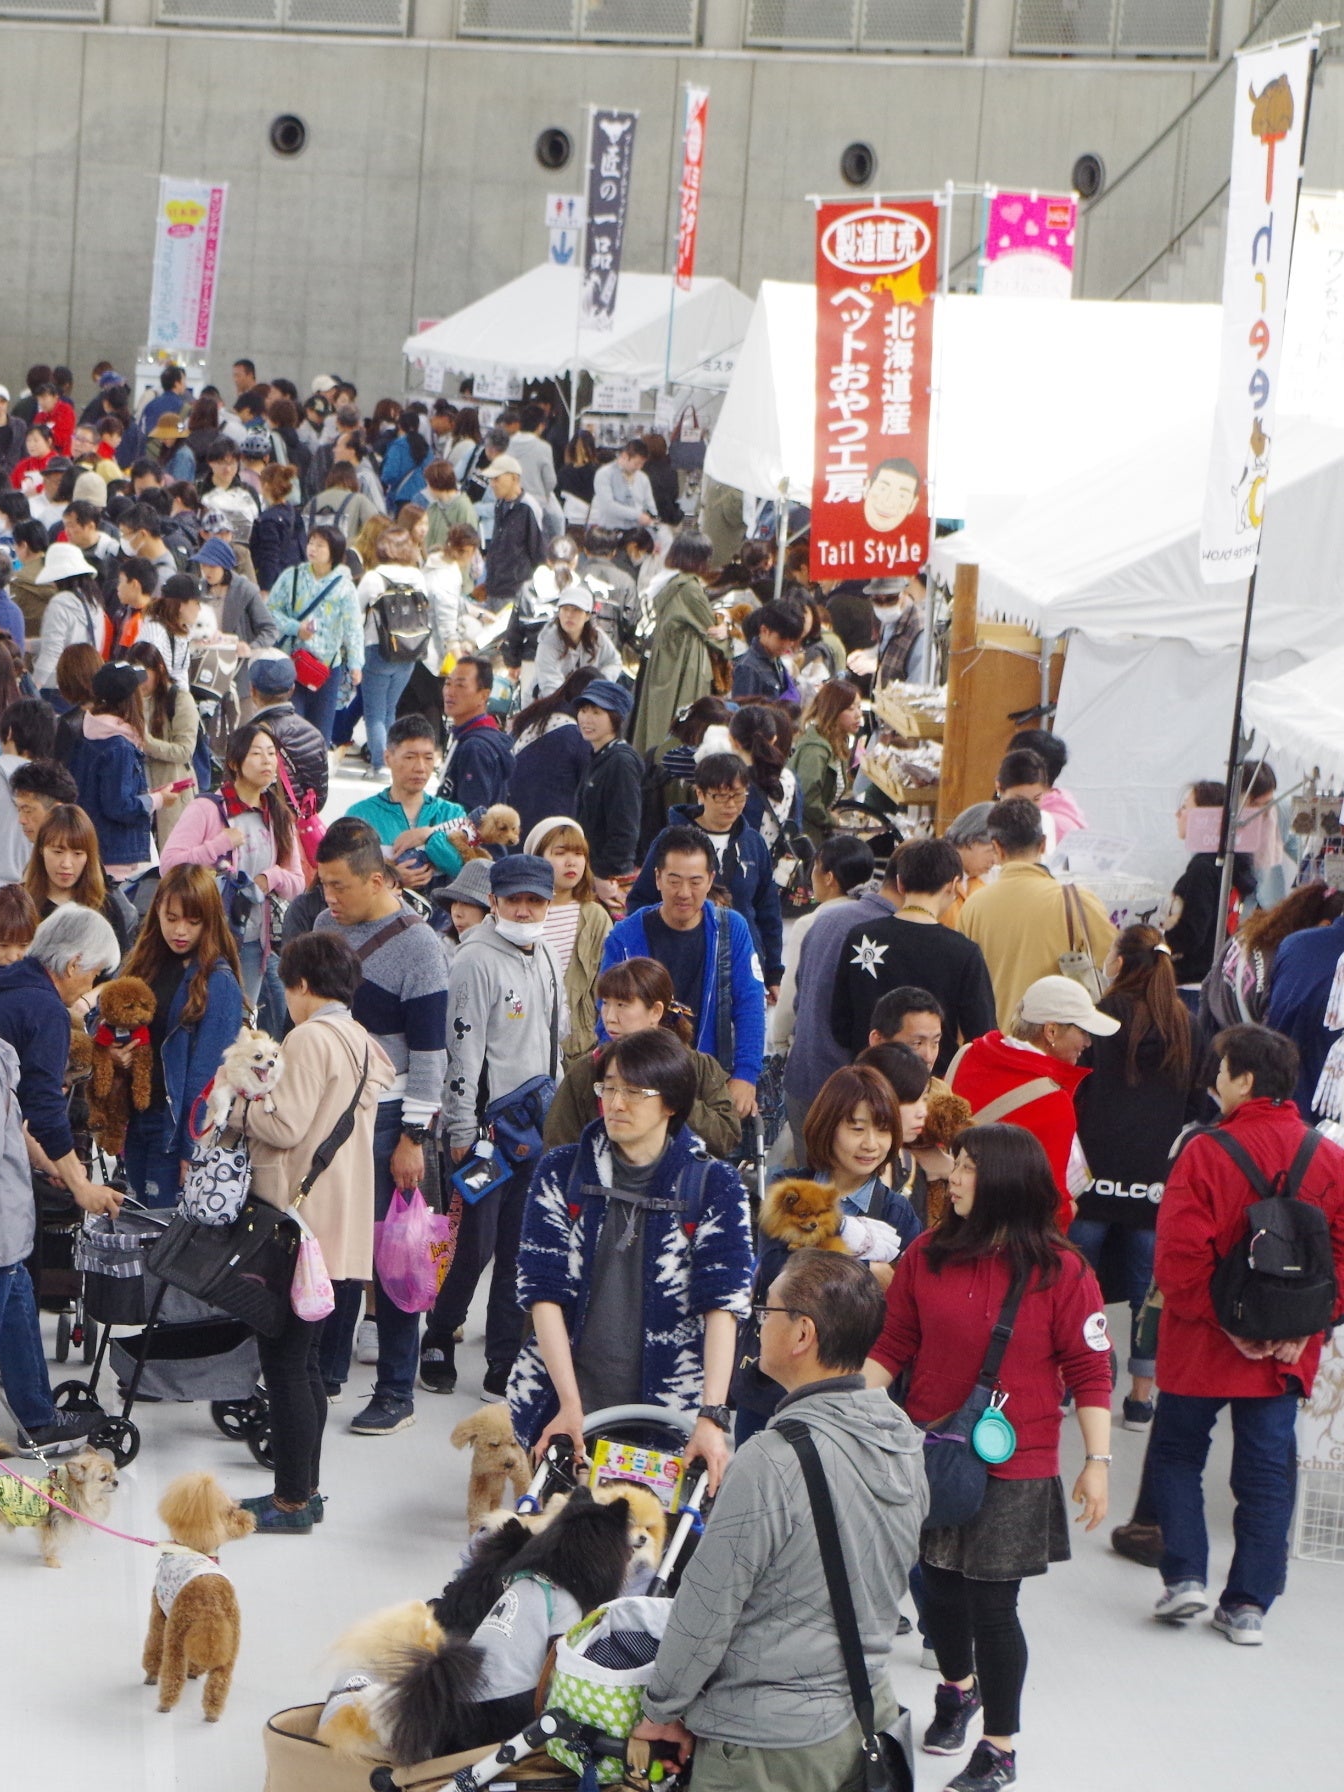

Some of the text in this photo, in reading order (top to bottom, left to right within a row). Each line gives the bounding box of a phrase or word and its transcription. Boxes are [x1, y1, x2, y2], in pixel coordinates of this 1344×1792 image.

[591, 146, 623, 270] 匠の一品
[834, 222, 918, 264] 製造直売
[823, 281, 873, 505] ペットおやつ工房
[879, 306, 916, 436] 北海道産
[817, 534, 923, 569] Tail Style
